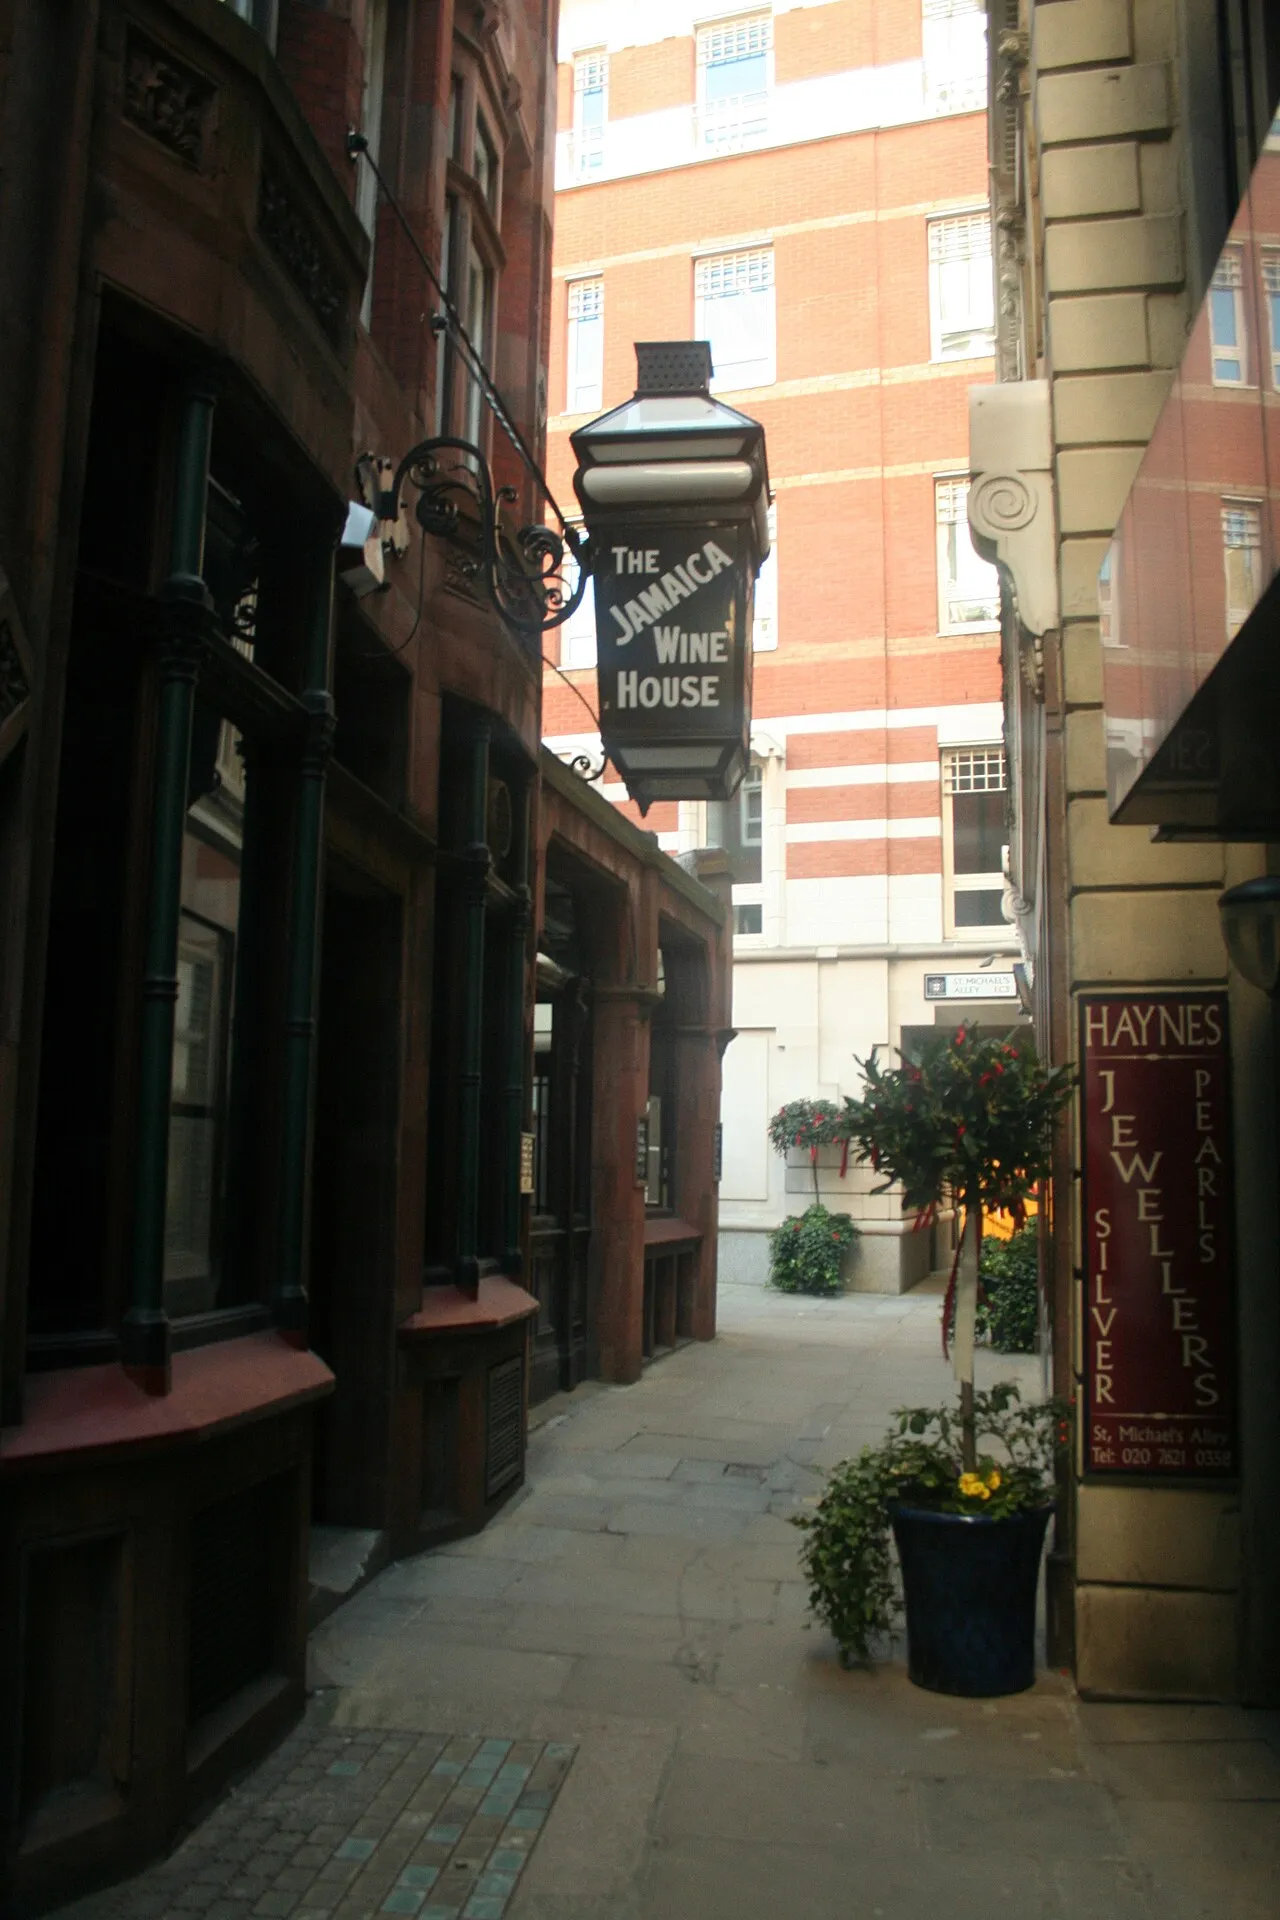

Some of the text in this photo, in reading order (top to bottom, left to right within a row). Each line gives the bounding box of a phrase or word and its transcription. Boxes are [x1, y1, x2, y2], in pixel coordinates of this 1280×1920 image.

[611, 546, 660, 574] THE
[608, 541, 734, 647] JAMAICA
[653, 625, 729, 664] WINE
[617, 670, 720, 709] HOUSE
[1084, 1004, 1223, 1047] HAYNES
[1194, 1068, 1223, 1264] PEARLS
[1098, 1069, 1221, 1408] JEWELLERS
[1091, 1208, 1118, 1404] SILVER
[1091, 1445, 1116, 1464] Tel:
[1121, 1447, 1153, 1465] 020
[1118, 1425, 1184, 1443] Michael's
[1189, 1427, 1229, 1446] Alley
